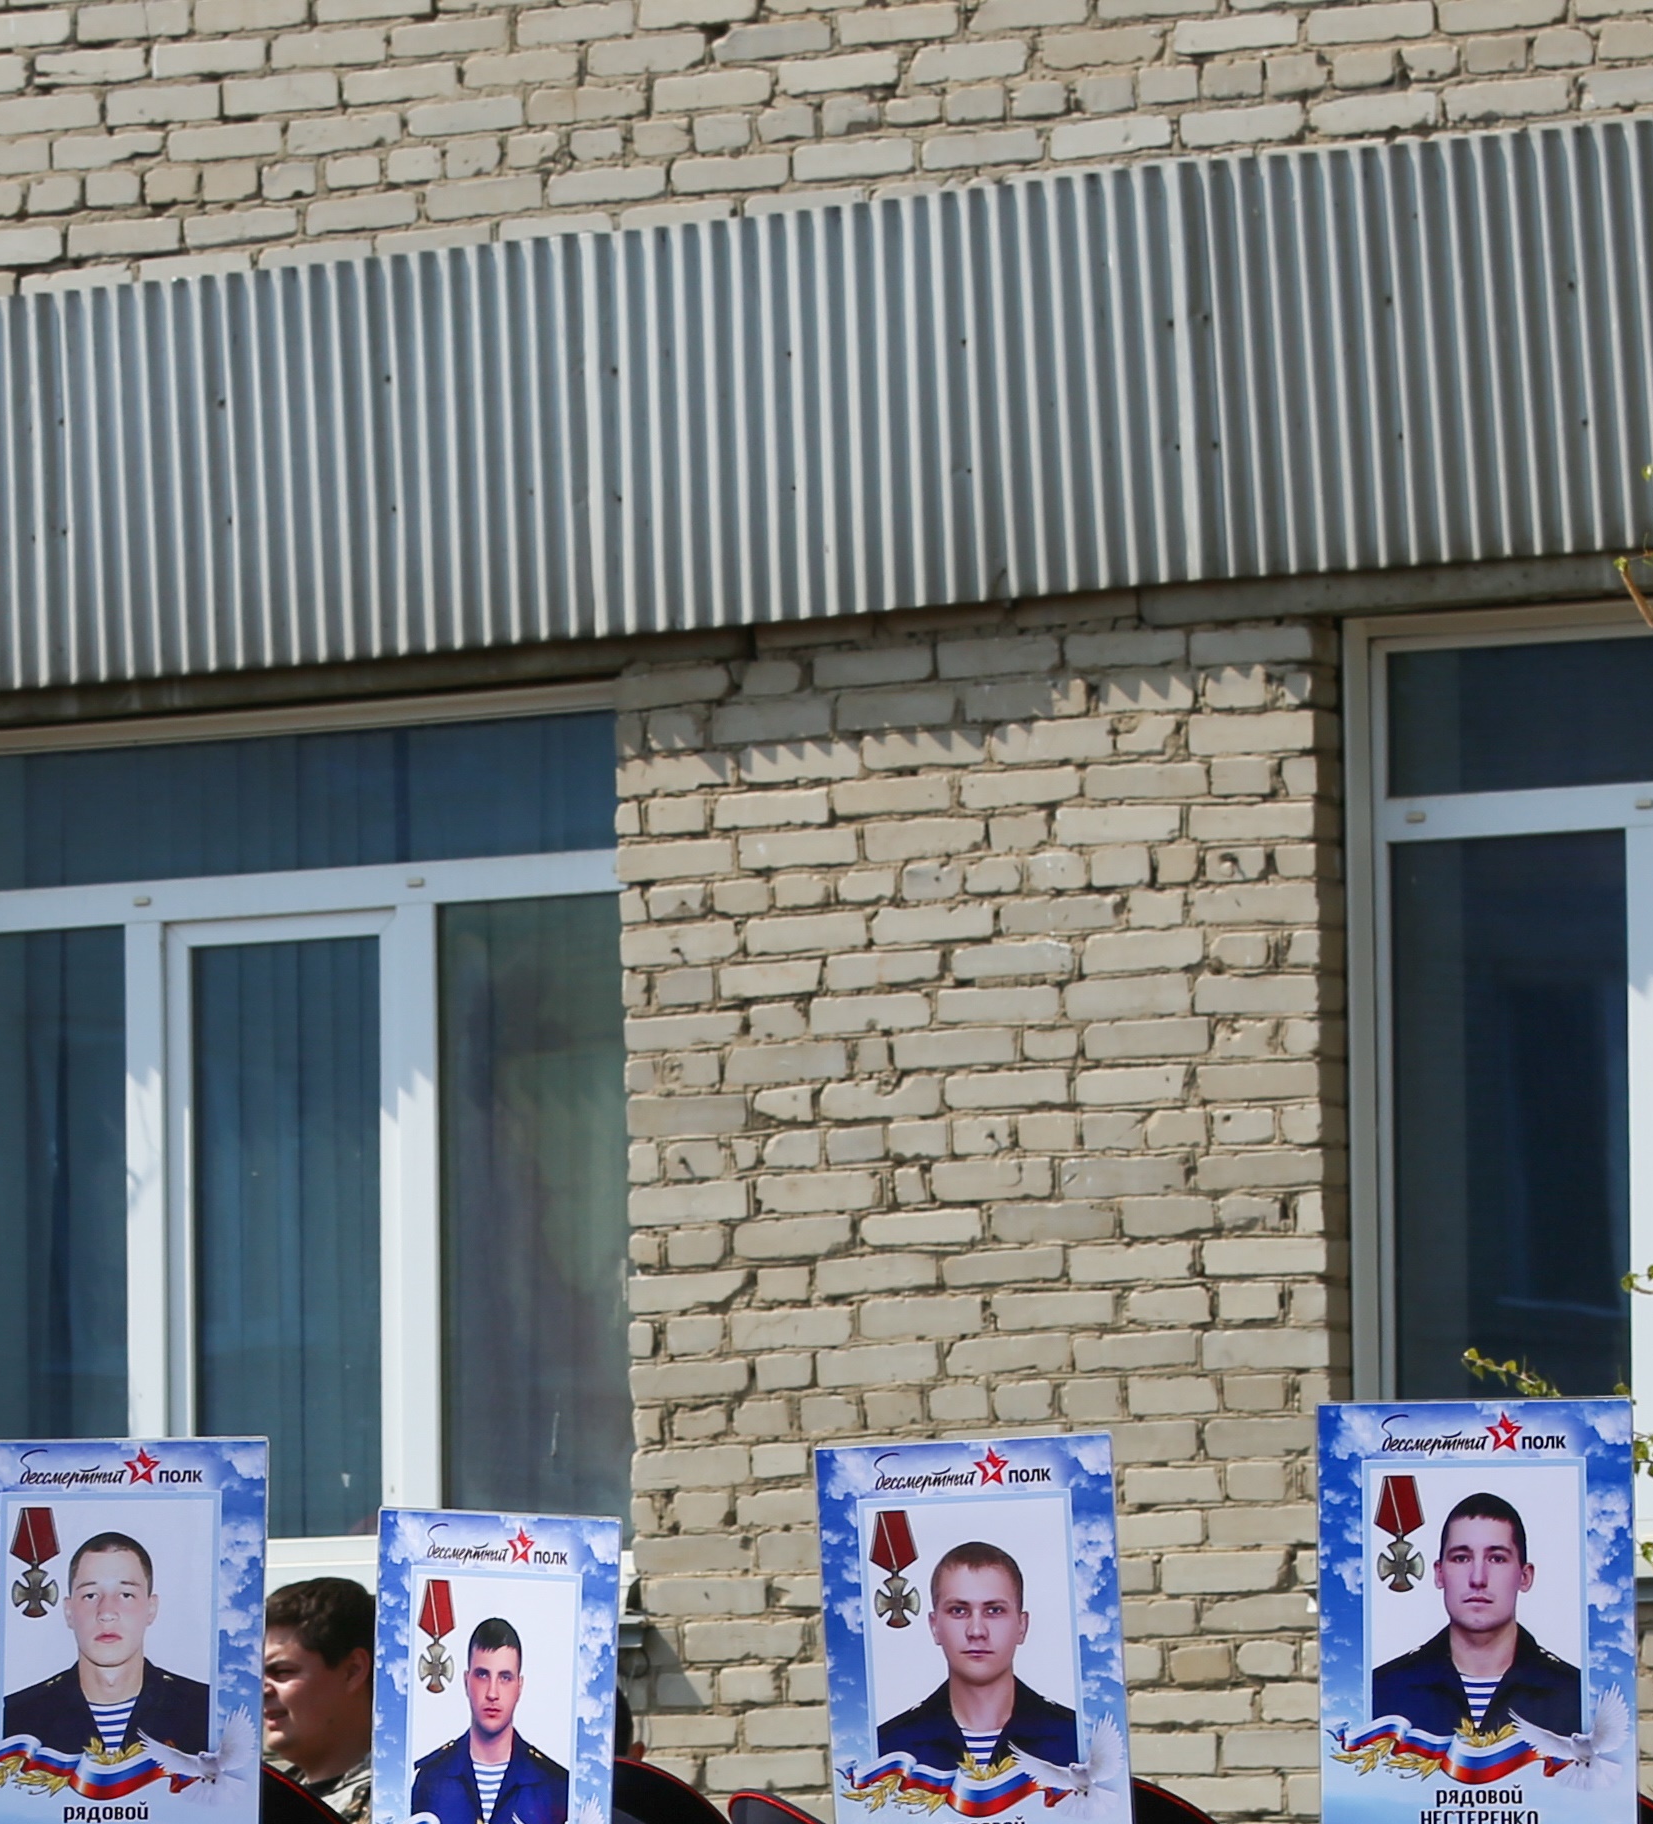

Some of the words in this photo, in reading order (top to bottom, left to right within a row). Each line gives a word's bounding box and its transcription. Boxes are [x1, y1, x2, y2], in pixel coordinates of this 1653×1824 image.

[1380, 1414, 1489, 1456] бессмертный
[19, 1449, 128, 1487] бессмертный
[874, 1453, 976, 1491] бессмертный
[426, 1523, 508, 1565] бессмертный
[63, 1801, 149, 1823] рядовой
[1435, 1785, 1523, 1809] рядовой
